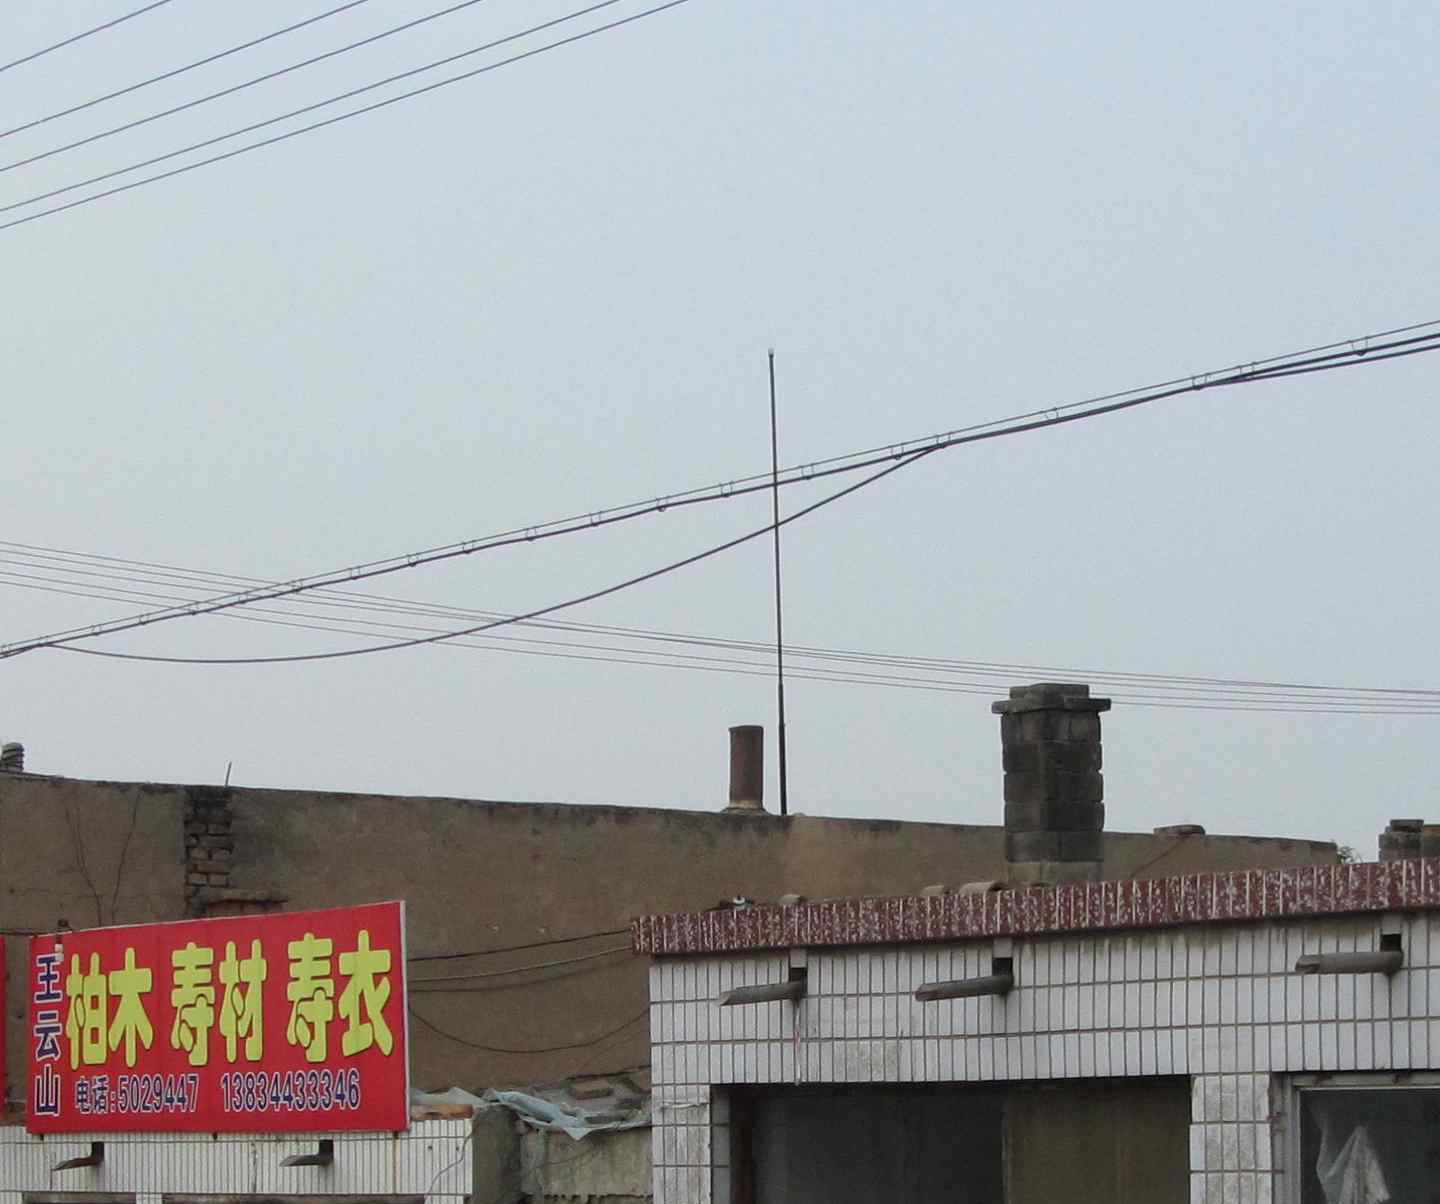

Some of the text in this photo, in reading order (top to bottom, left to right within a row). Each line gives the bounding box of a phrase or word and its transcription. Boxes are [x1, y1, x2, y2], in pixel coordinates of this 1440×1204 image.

[34, 953, 62, 1117] 王云山
[65, 930, 394, 1070] 柏木 寿材 寿衣
[220, 1068, 361, 1114] 13834433346
